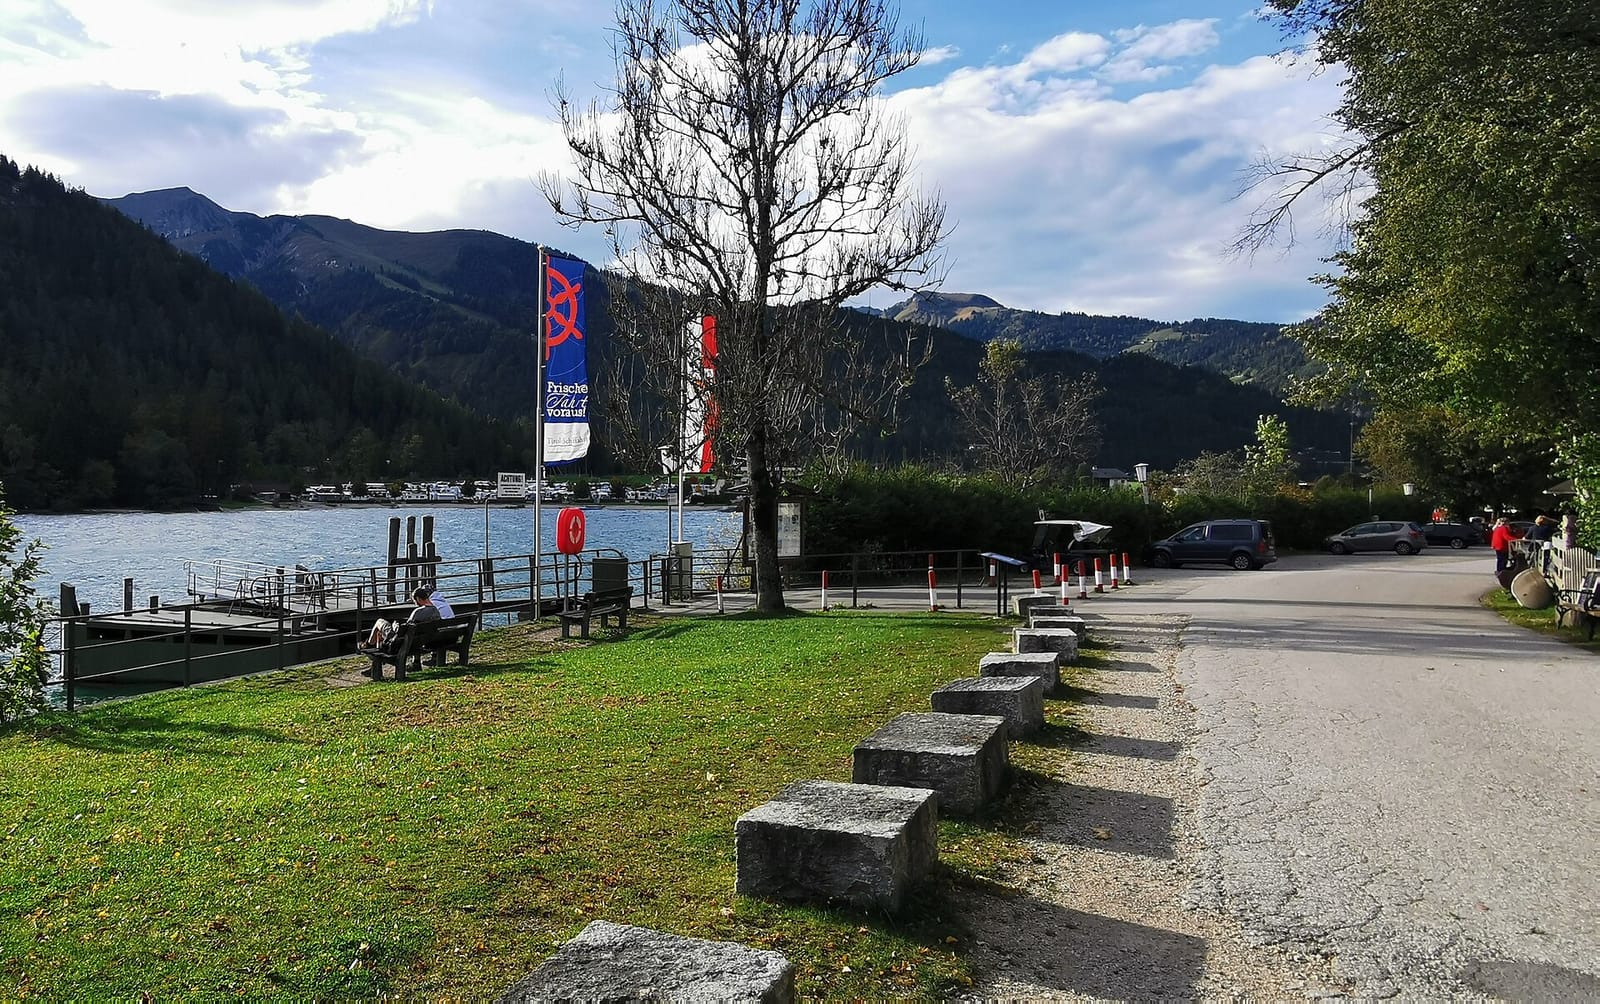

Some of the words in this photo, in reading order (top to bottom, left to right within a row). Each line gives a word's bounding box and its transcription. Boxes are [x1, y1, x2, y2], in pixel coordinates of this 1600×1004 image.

[547, 381, 589, 394] Frische
[546, 392, 589, 409] Fahrt
[546, 407, 587, 417] voraus!
